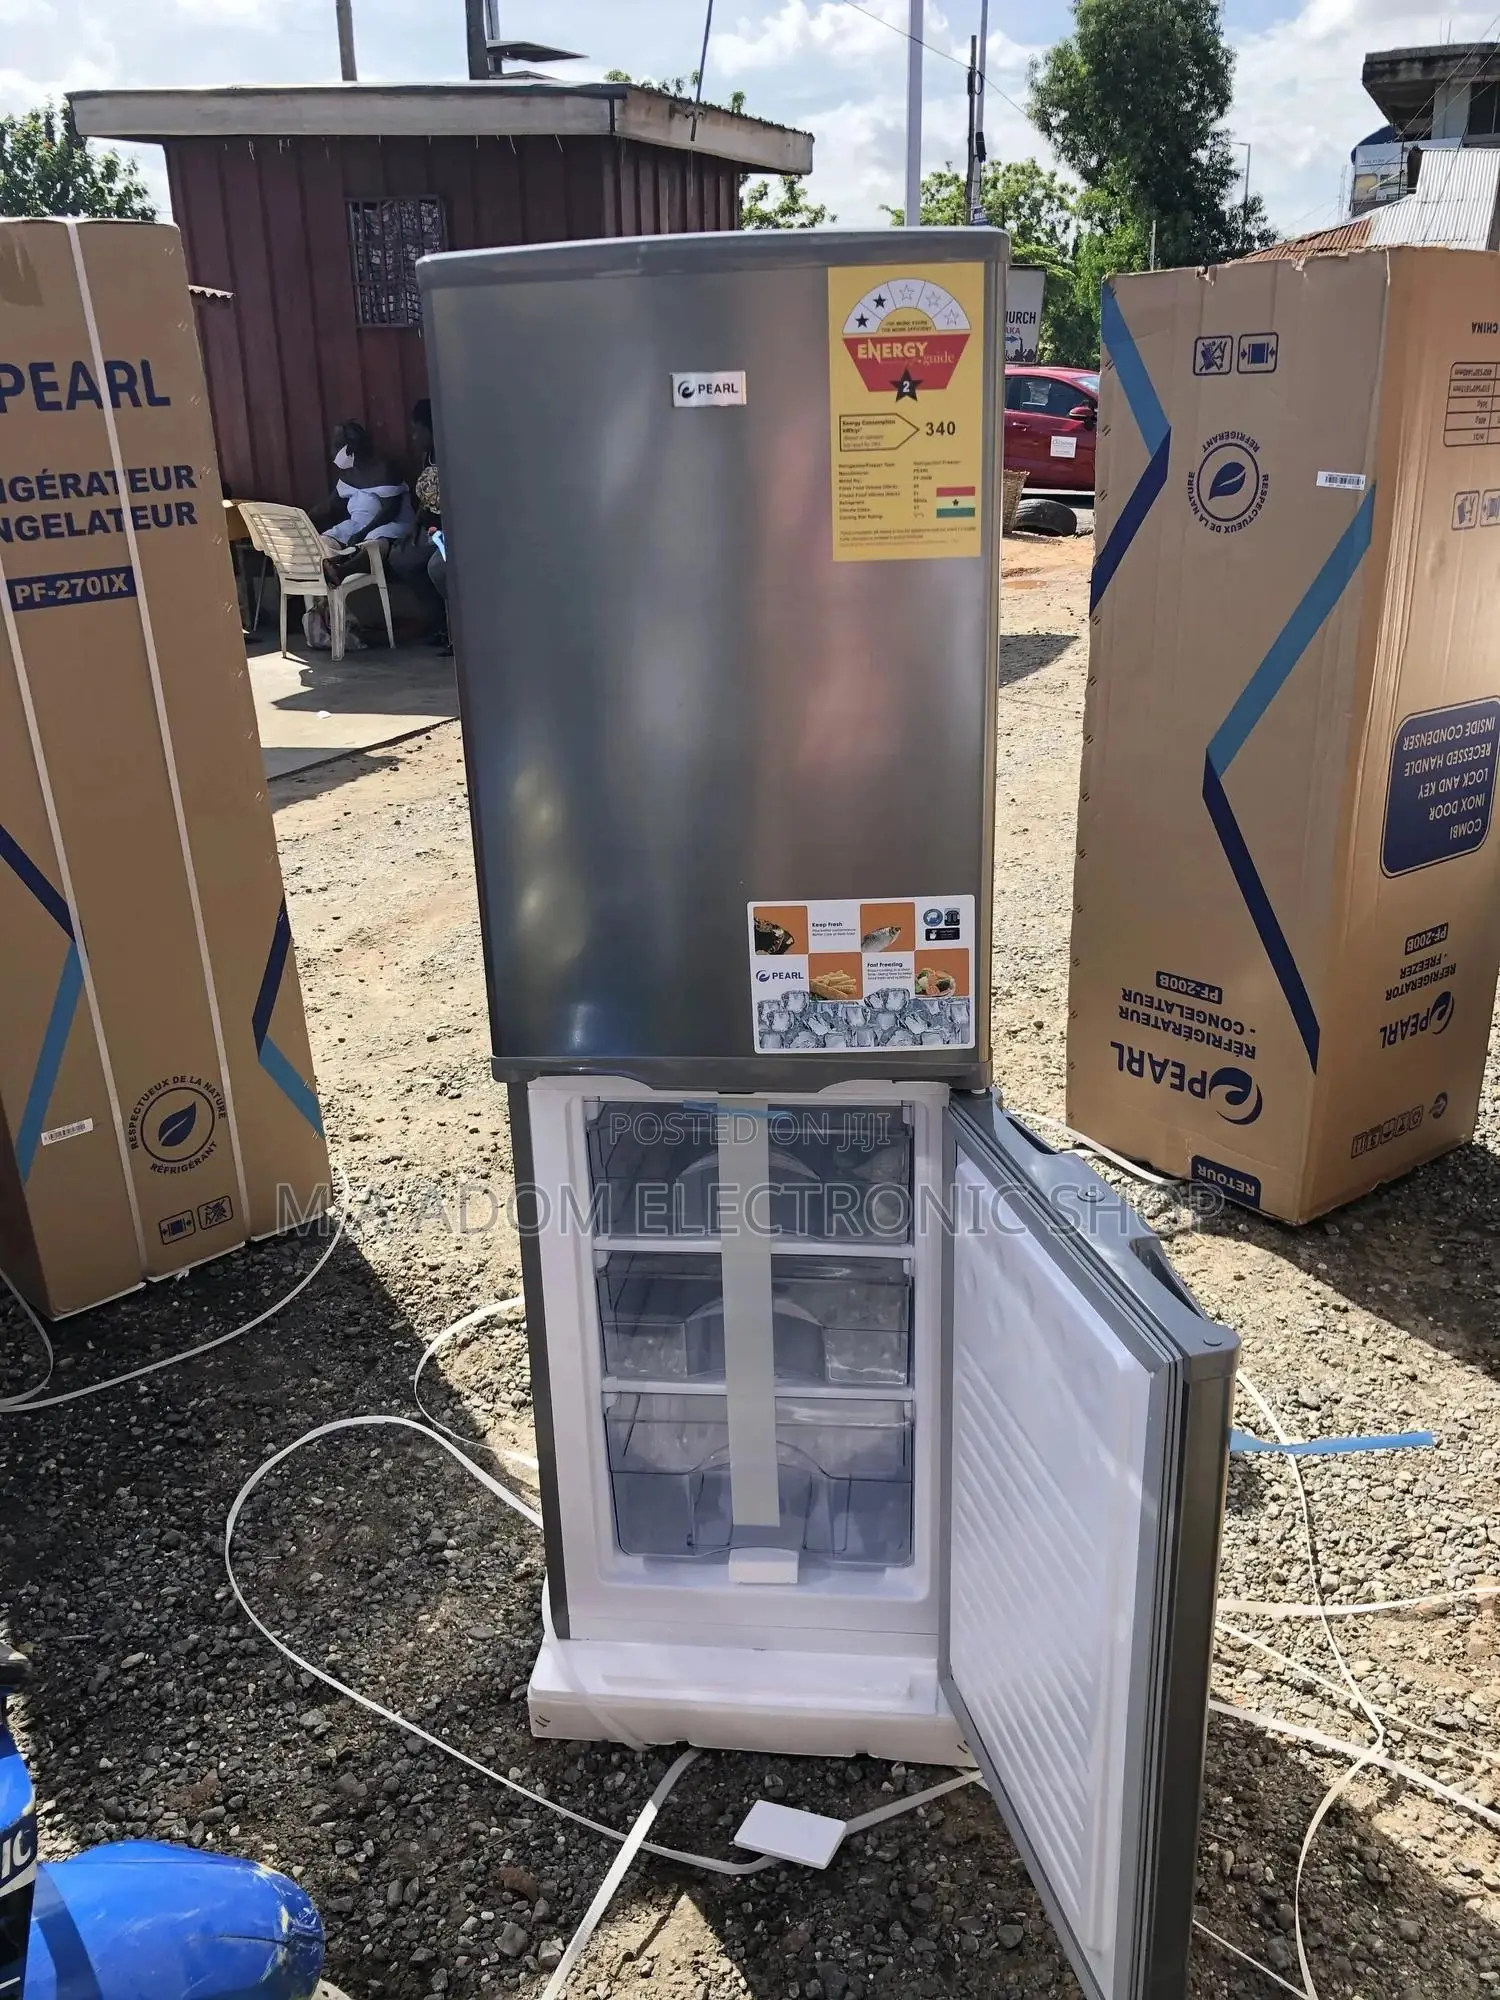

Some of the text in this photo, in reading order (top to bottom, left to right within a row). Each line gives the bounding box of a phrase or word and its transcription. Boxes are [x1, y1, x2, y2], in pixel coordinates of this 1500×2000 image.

[1471, 321, 1499, 335] CHINA
[857, 339, 929, 364] ENERGY
[923, 350, 955, 366] guide
[0, 359, 171, 413] PEARL
[698, 383, 739, 395] PEARL
[902, 380, 911, 393] 2
[925, 421, 956, 436] 340
[1187, 471, 1269, 534] RESPECTUEUX DE LA NATURE
[14, 573, 129, 605] PF-270IX
[1402, 716, 1496, 751] INSIDE CONDENSER
[1404, 741, 1492, 777] RECESSED HANDLE
[1417, 767, 1489, 800] LOCK AND KEY
[1428, 792, 1486, 821] INOX DOOR
[1449, 818, 1482, 840] COMBI
[1406, 924, 1448, 952] PF-200B
[772, 972, 805, 980] PEARL
[1385, 963, 1457, 1001] REFRIGERATOR
[1399, 953, 1442, 979] FREEZER
[1159, 974, 1220, 1001] PF-200B
[1121, 987, 1245, 1036] CONGELATEUR
[1118, 1005, 1257, 1060] RÉFRIGÉRATEUR
[1379, 1007, 1431, 1049] PEARL
[1110, 1040, 1208, 1100] PEARL
[128, 1075, 228, 1151] RESPECTUEUX DE LA NATURE
[1197, 1164, 1256, 1198] RETOUR
